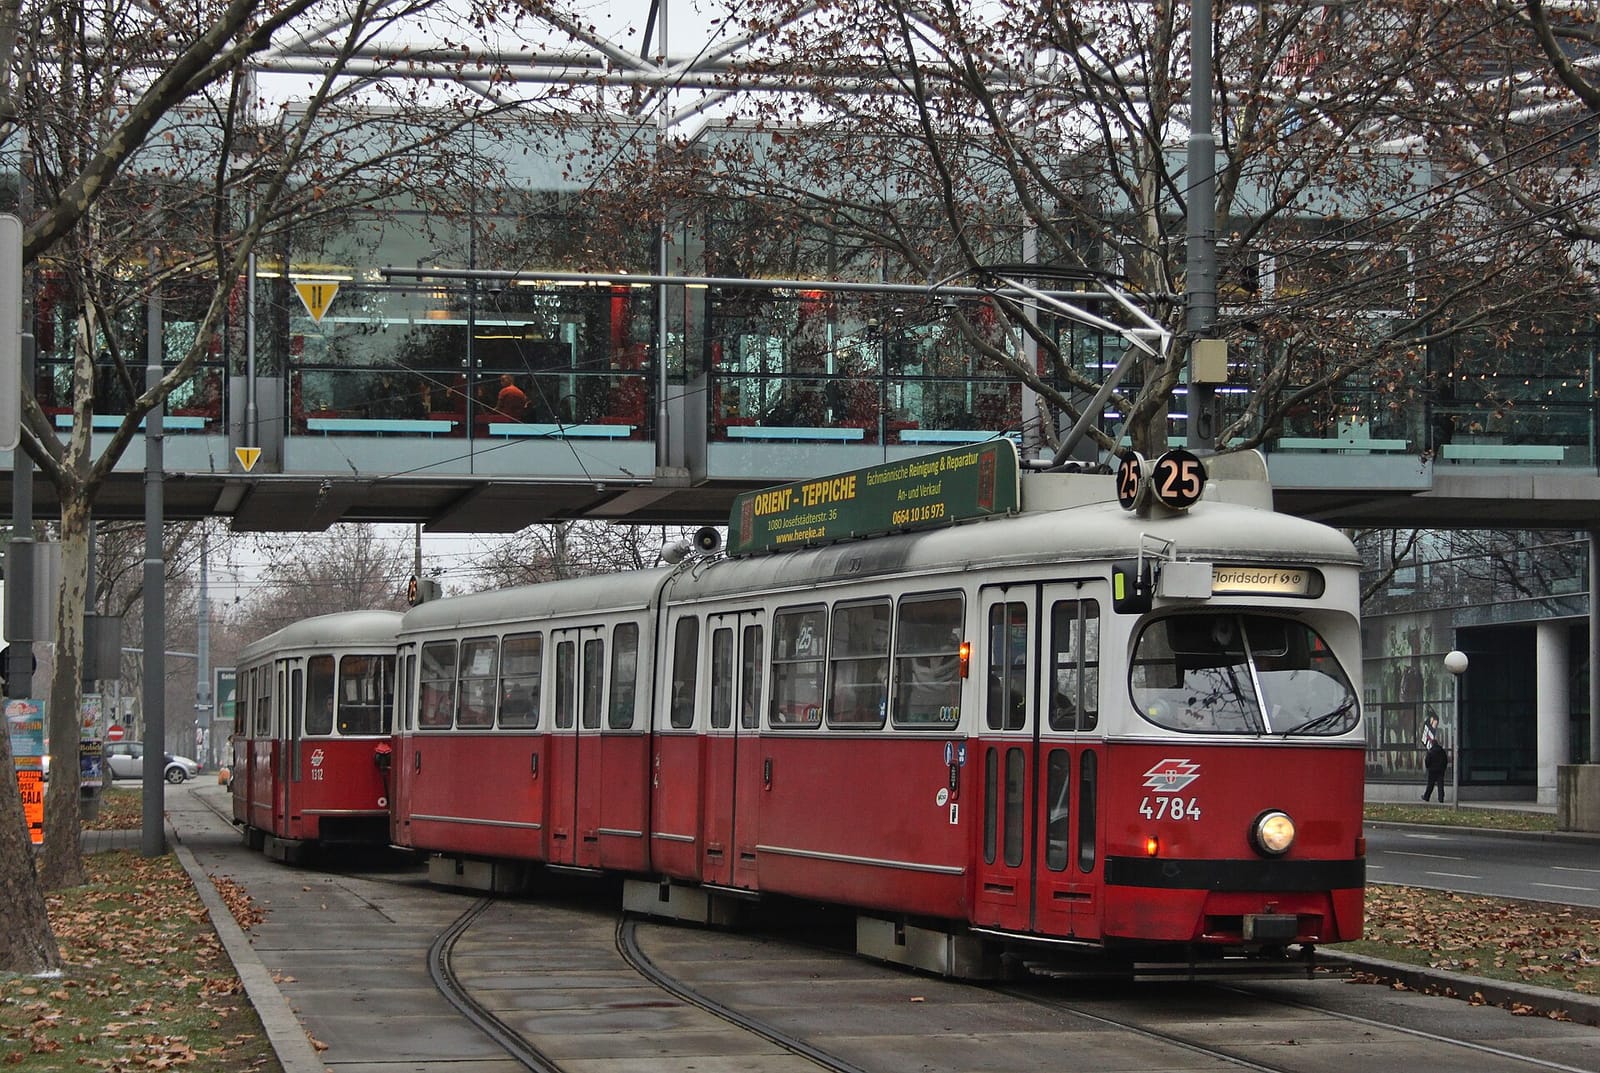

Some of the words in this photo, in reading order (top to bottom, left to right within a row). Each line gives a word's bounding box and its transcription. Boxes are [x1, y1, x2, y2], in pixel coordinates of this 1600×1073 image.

[866, 467, 908, 486] fachmännische
[909, 460, 939, 478] Reinigung
[939, 456, 946, 471] &
[946, 452, 979, 472] Reparatur
[1120, 459, 1138, 499] 25
[1160, 459, 1200, 499] 25
[754, 488, 793, 516] ORIENT
[801, 475, 857, 507] TEPPICHE
[897, 488, 908, 501] An-
[908, 486, 919, 499] und
[919, 480, 942, 498] Verkauf
[767, 518, 782, 531] 1080
[782, 511, 827, 529] Josefstädterstr.
[828, 508, 838, 521] 36
[892, 509, 909, 525] 0664
[910, 507, 920, 522] 10
[920, 505, 930, 520] 16
[930, 502, 945, 518] 973
[775, 526, 826, 544] www.hereke.at
[22, 791, 42, 804] GALA
[1138, 796, 1201, 821] 4784
